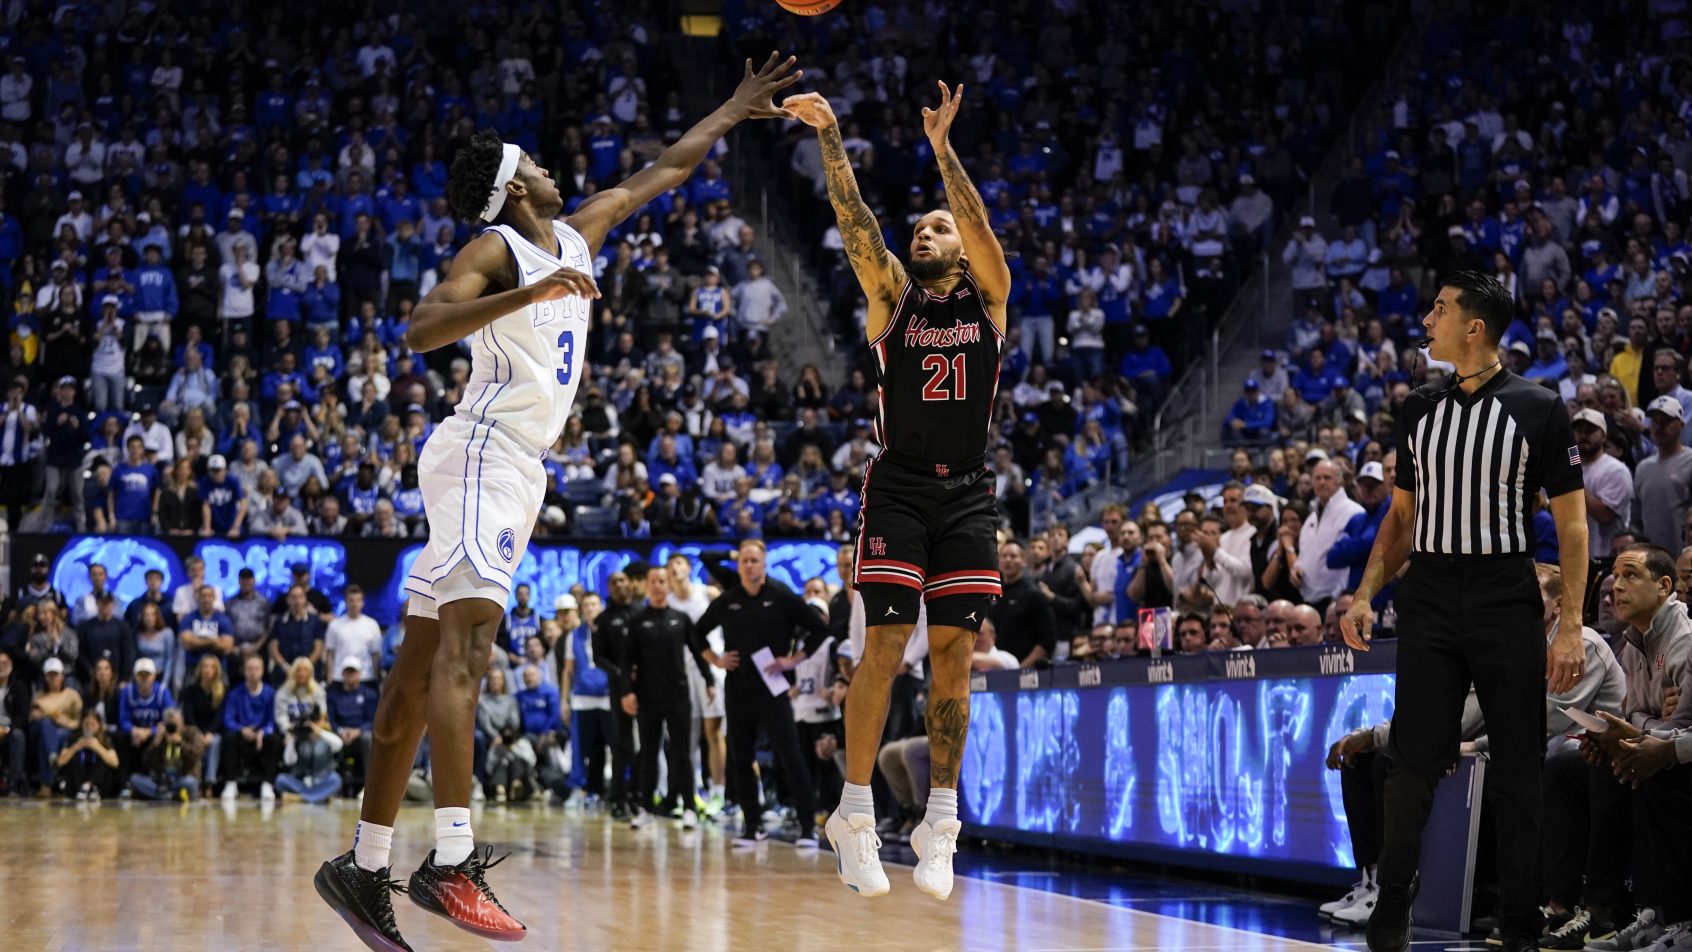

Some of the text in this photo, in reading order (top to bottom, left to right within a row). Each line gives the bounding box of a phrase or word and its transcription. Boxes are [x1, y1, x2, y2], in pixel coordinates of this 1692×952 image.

[905, 314, 980, 348] Houston
[557, 331, 574, 385] 3
[922, 353, 966, 401] 21
[869, 537, 887, 556] UH
[1147, 660, 1167, 682] vivint
[1226, 653, 1250, 678] vivint
[1319, 646, 1346, 675] vivint
